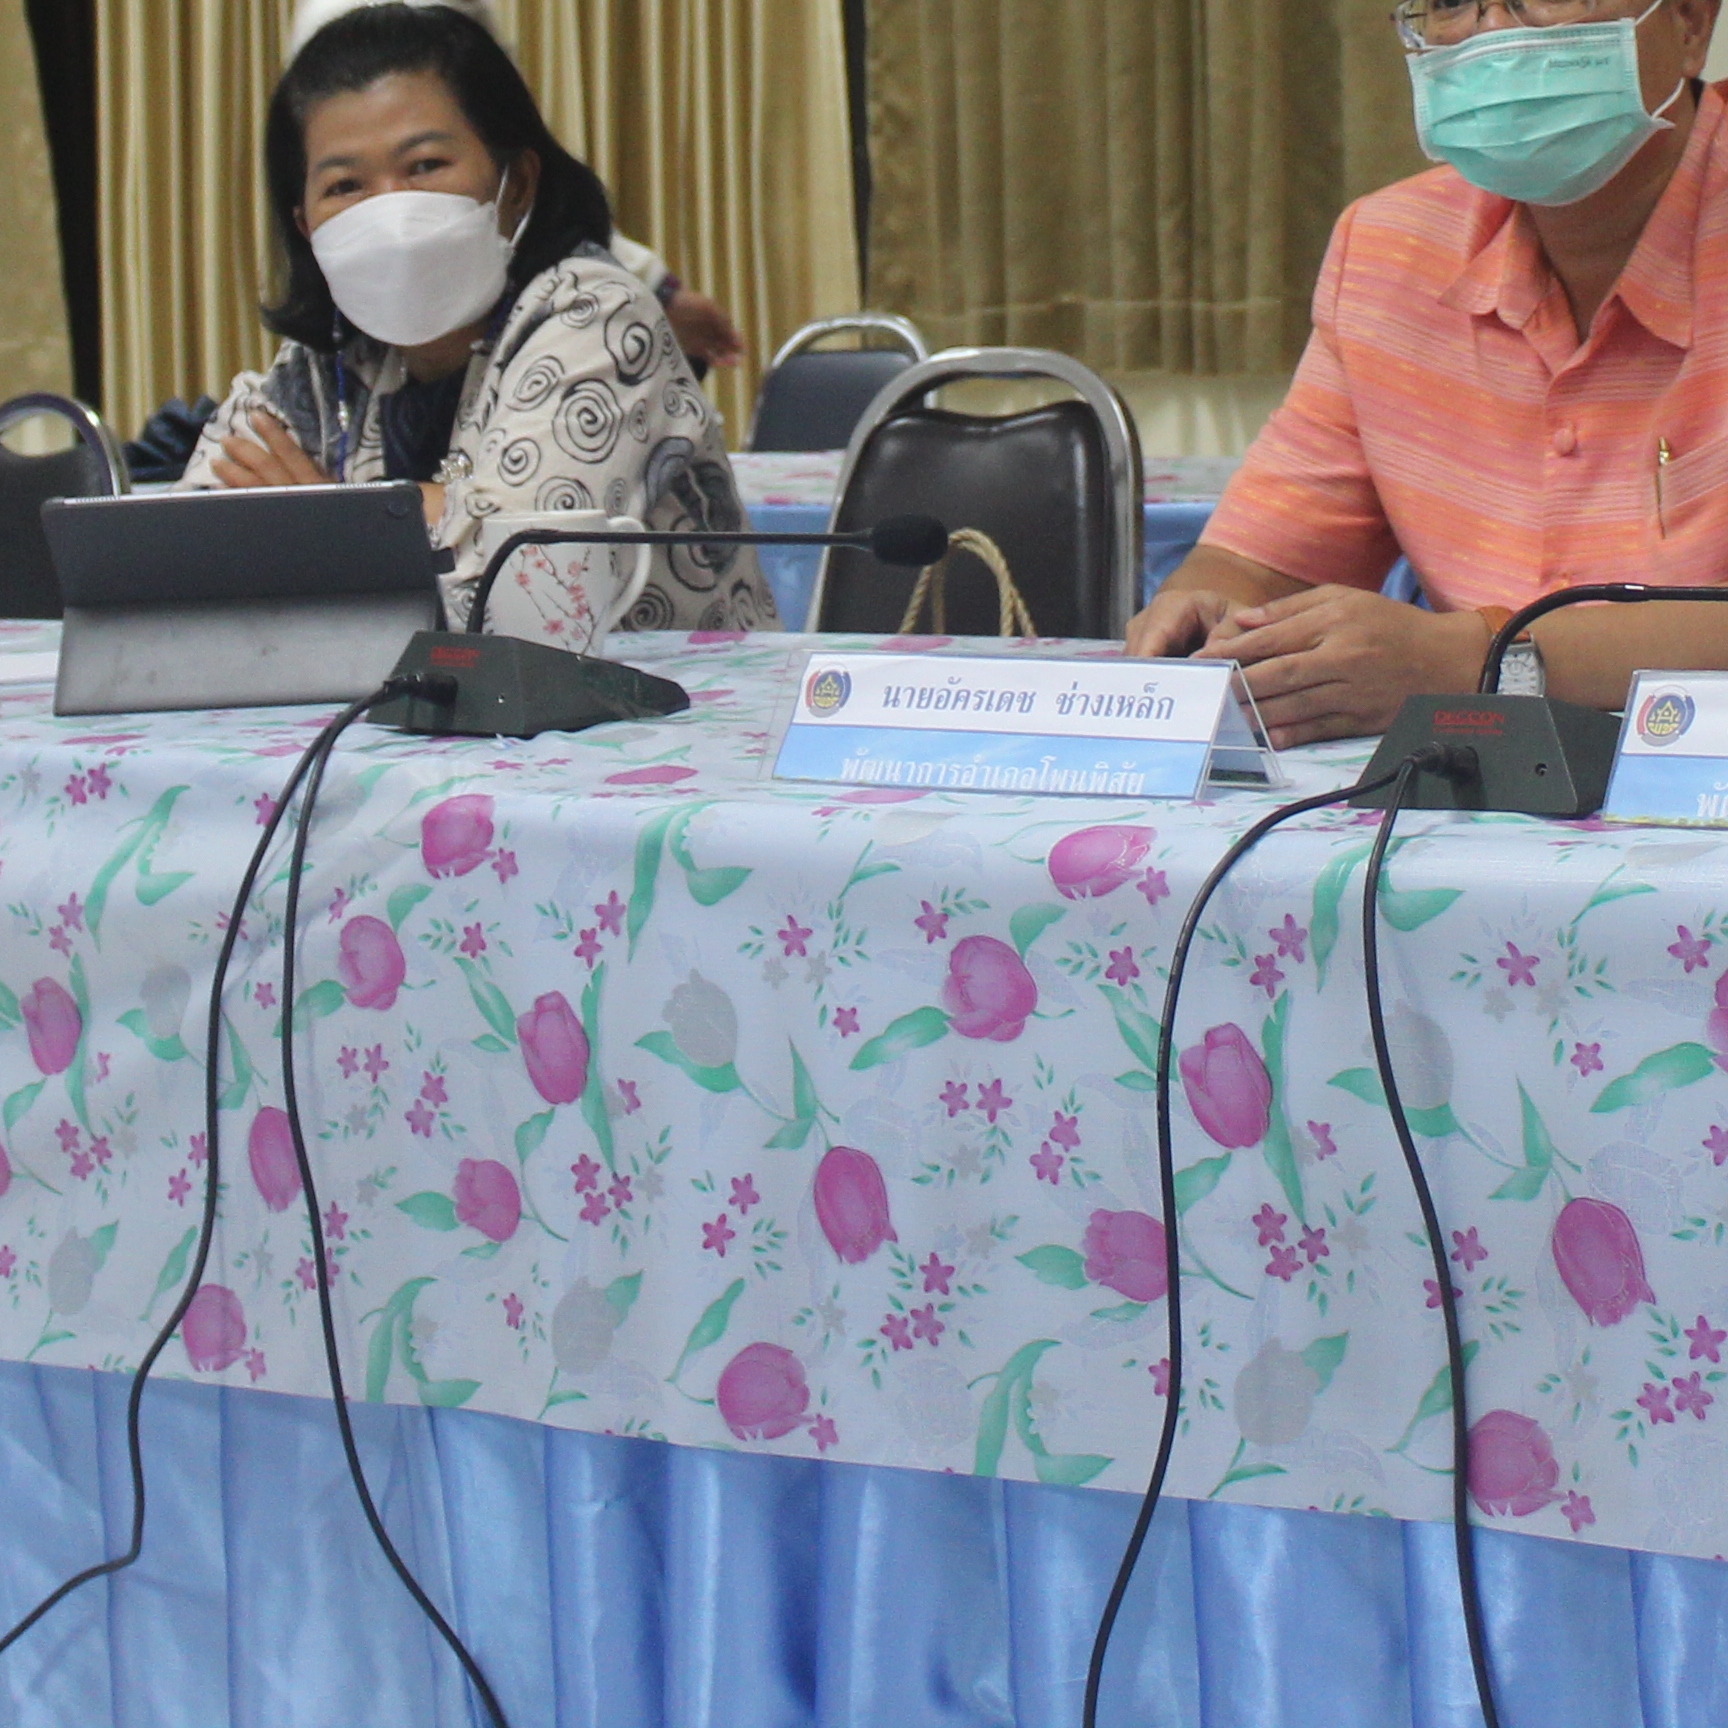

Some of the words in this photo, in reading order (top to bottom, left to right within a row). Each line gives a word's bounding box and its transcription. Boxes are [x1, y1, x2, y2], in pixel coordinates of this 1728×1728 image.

[881, 676, 1037, 714] นายอัครเดช
[1055, 681, 1175, 720] ช่างเหล็ก
[840, 747, 1147, 796] พัฒนาการอำเภอโพนพิสัย
